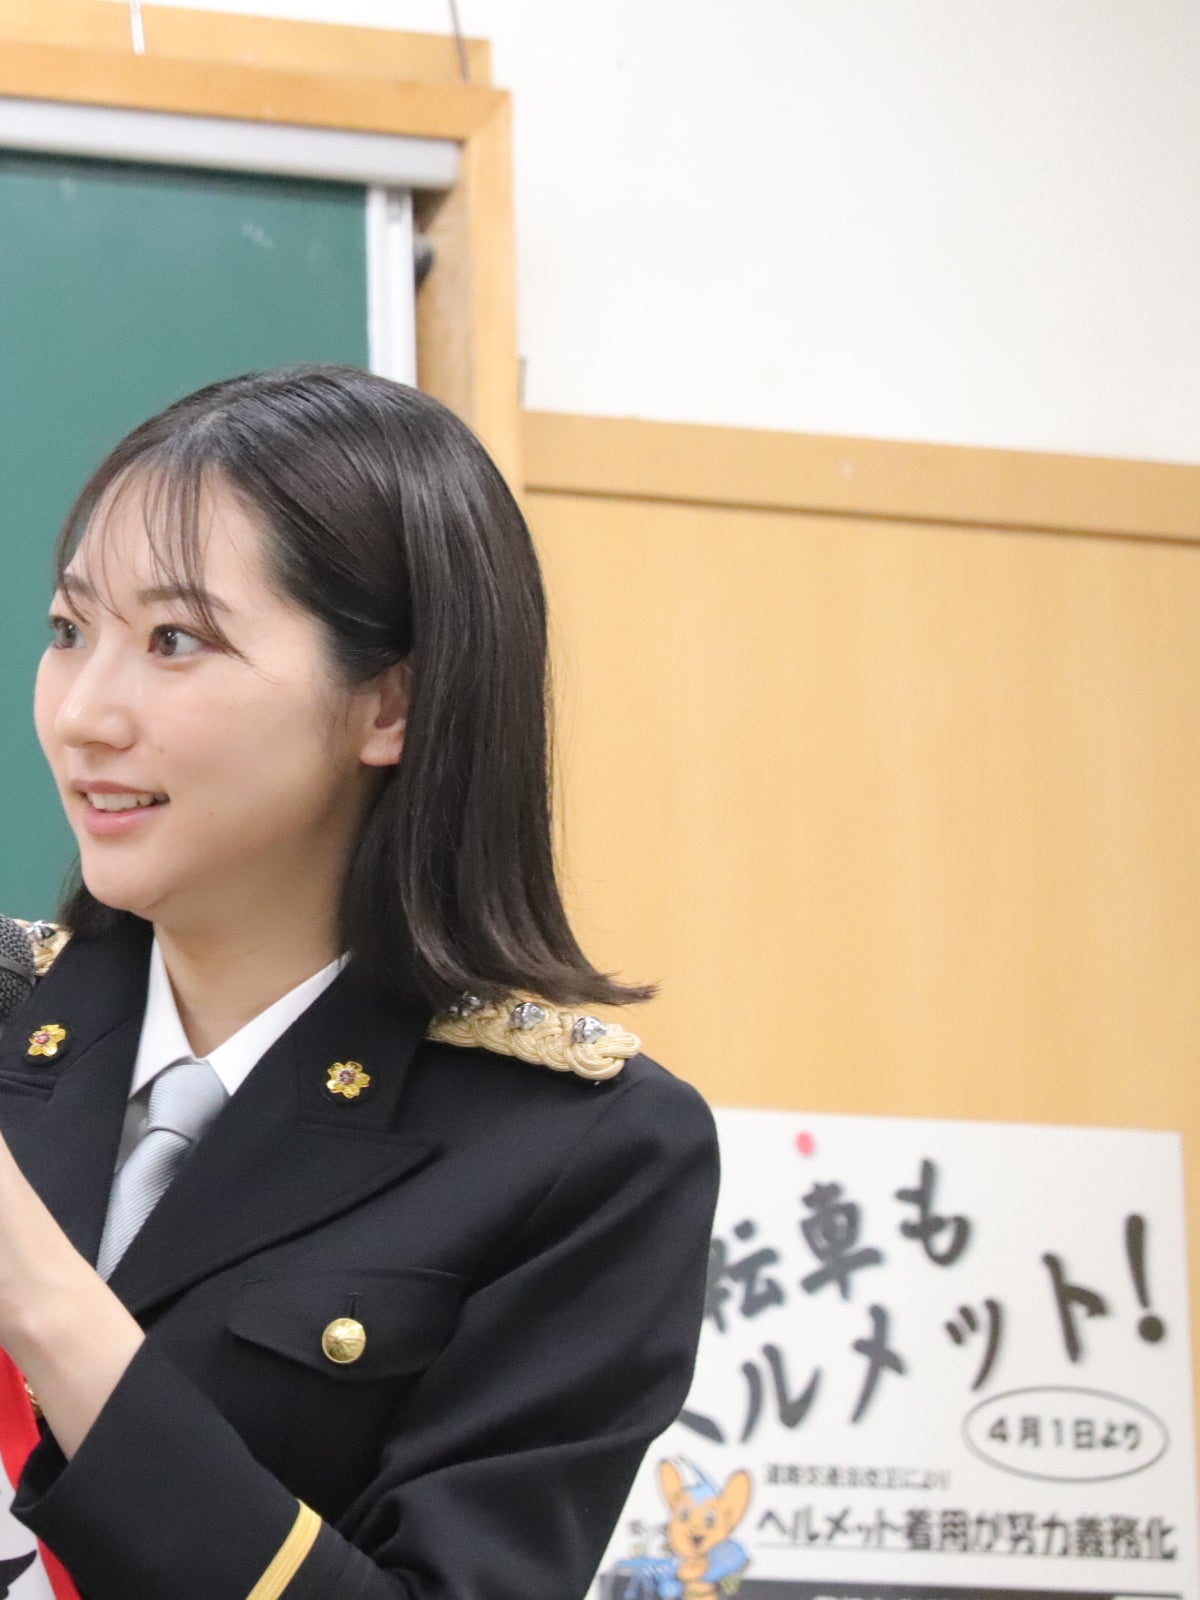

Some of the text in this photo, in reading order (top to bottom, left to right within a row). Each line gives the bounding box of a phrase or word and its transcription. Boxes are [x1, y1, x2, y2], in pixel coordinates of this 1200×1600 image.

[987, 1415, 1143, 1452] 4月1日より
[756, 1507, 1179, 1562] ヘルメット着用が努力義務化
